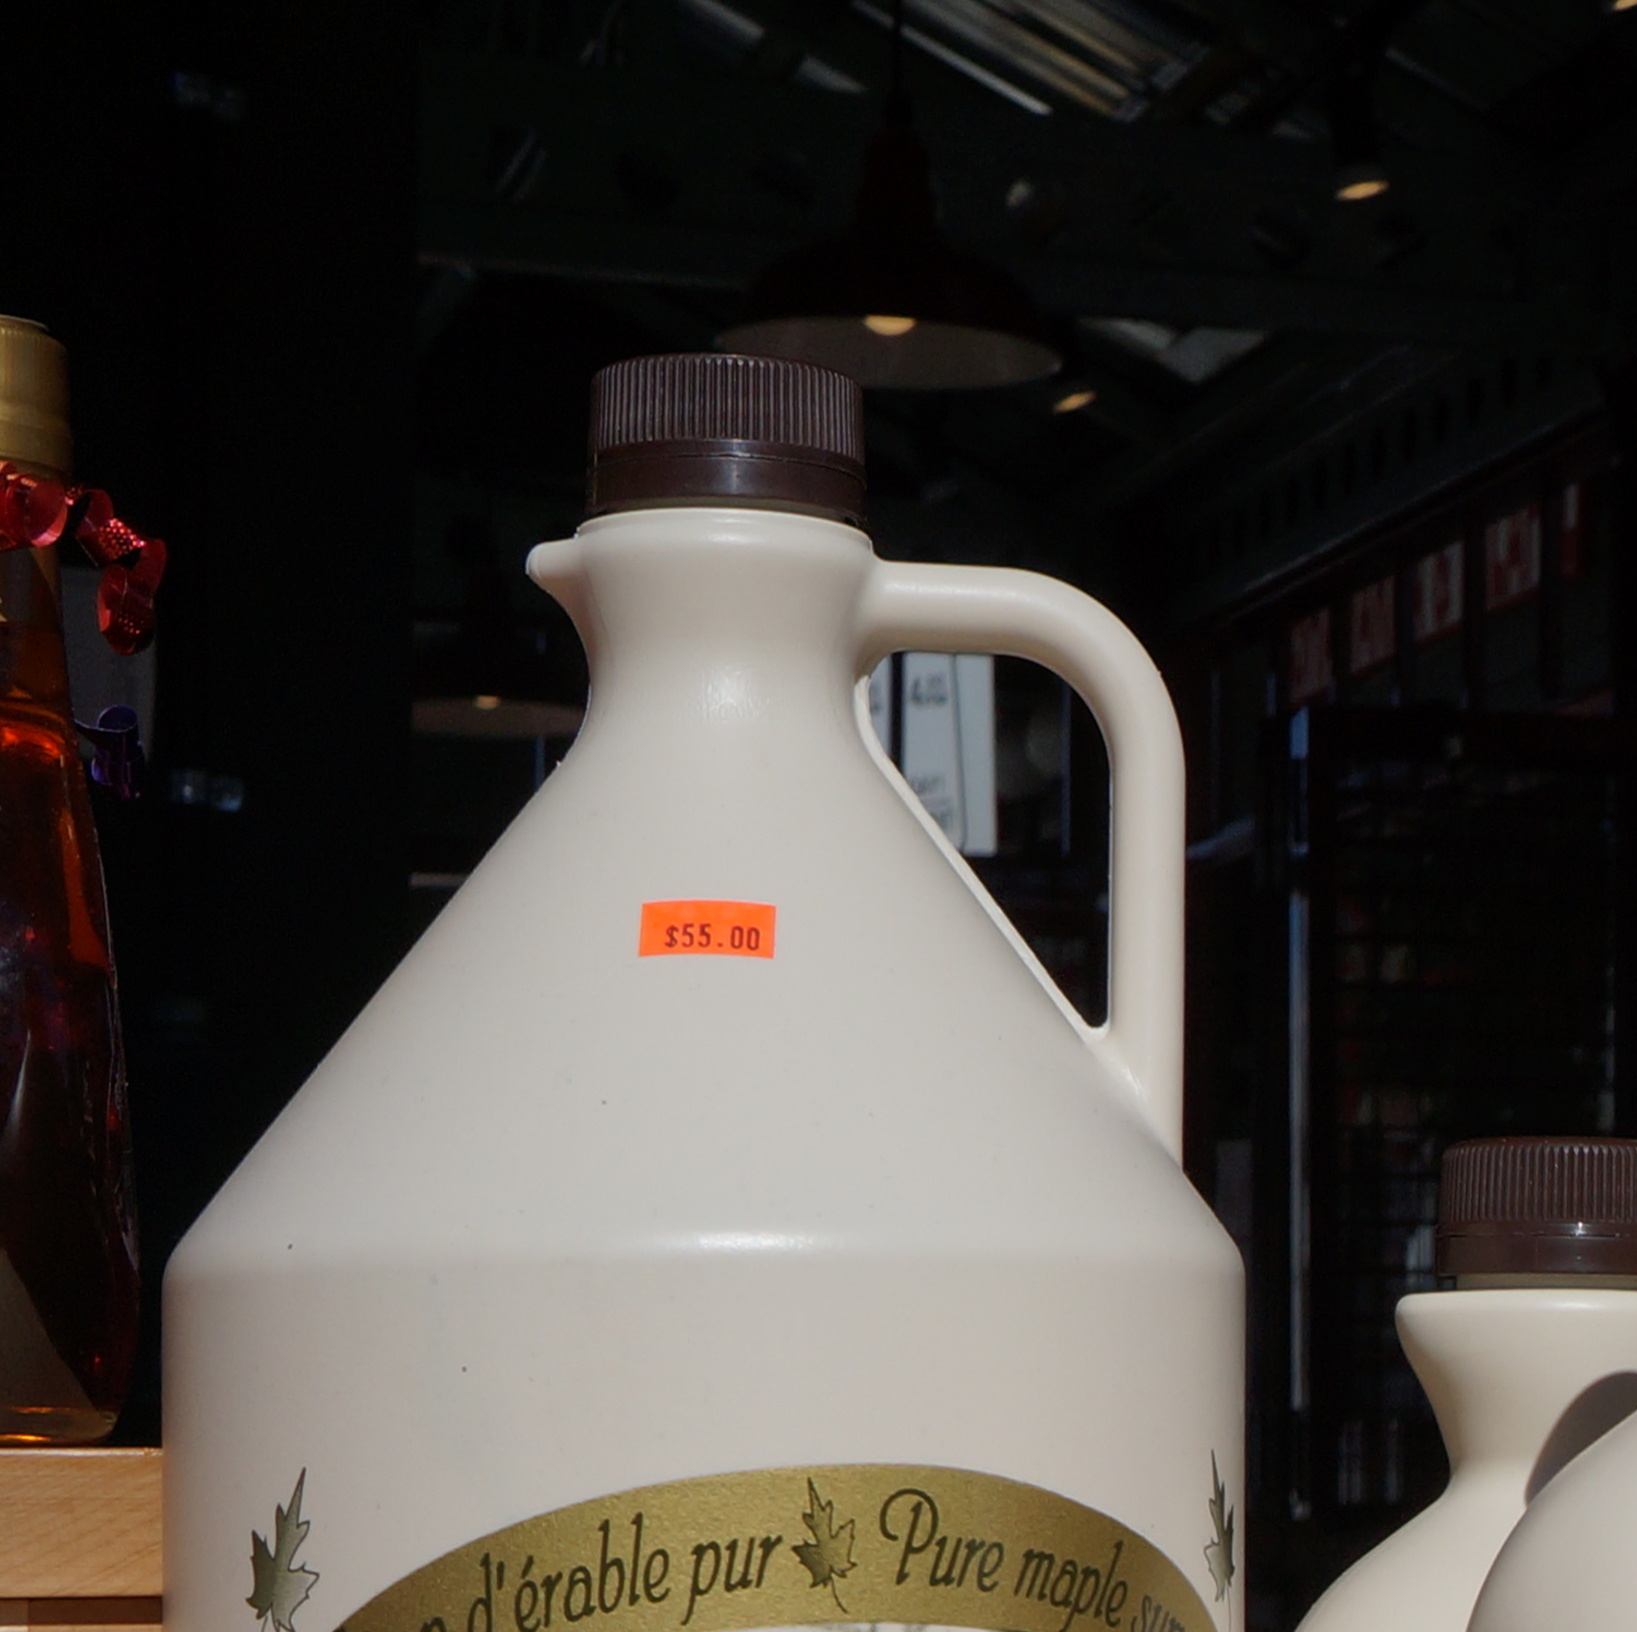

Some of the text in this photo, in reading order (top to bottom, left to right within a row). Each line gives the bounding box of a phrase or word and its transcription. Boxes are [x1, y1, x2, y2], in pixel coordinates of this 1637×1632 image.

[664, 923, 760, 951] $55.00
[677, 1534, 784, 1626] pur
[879, 1487, 1003, 1594] Pure
[1012, 1540, 1132, 1632] maple
